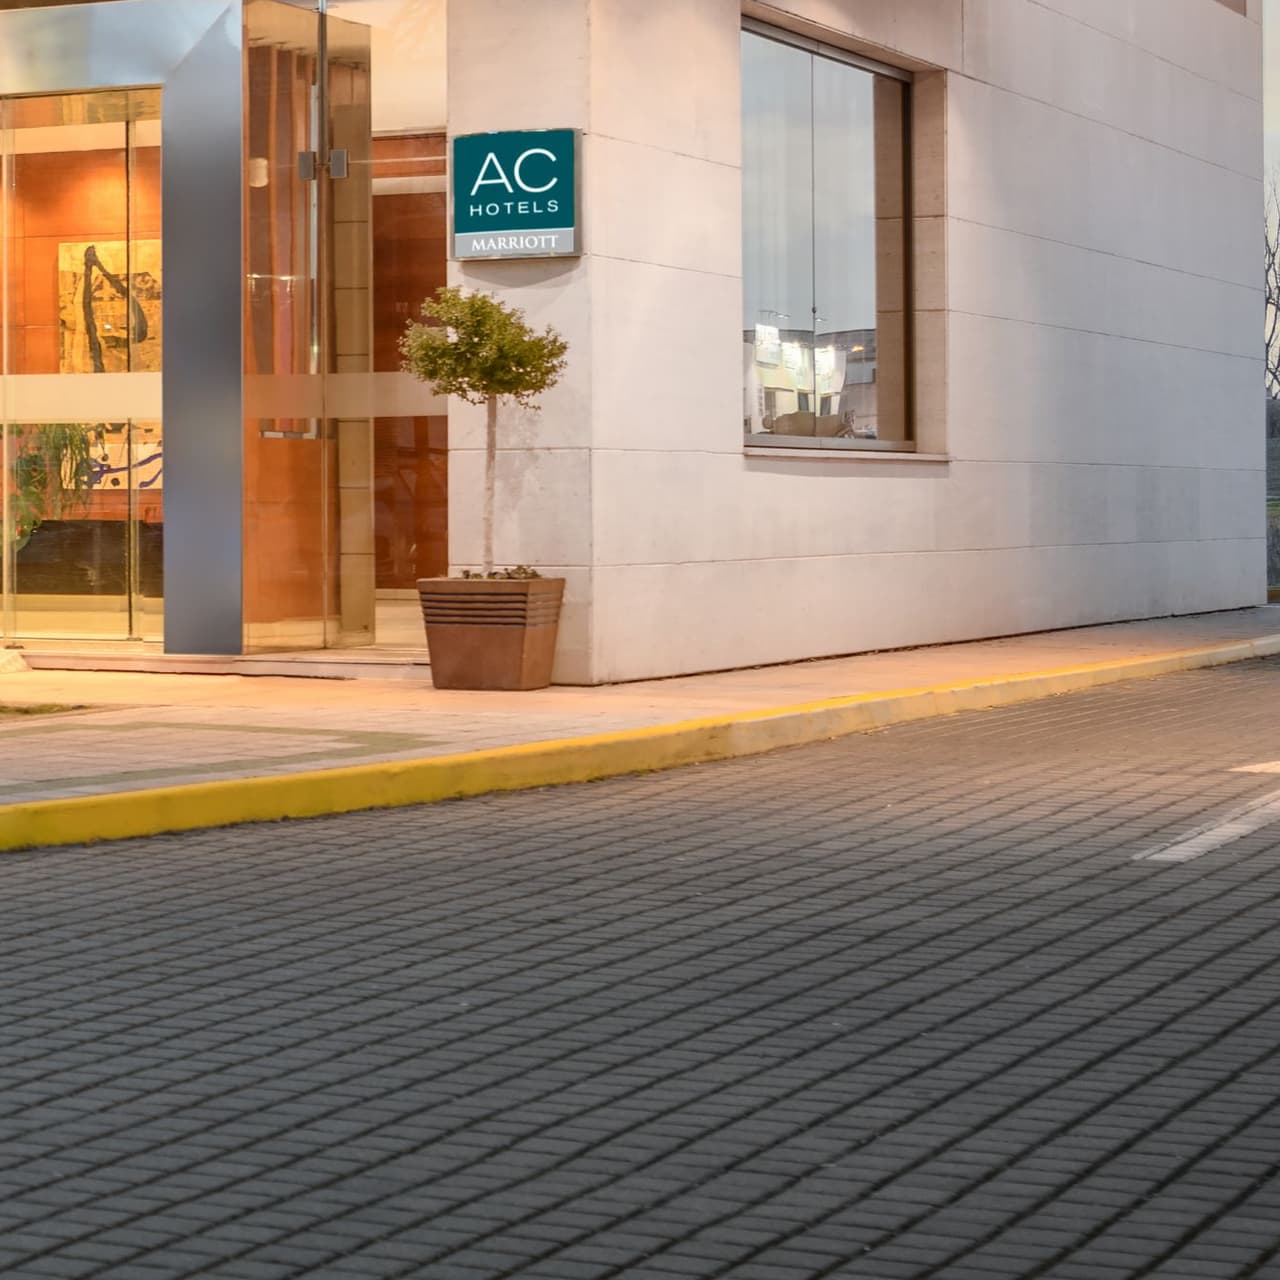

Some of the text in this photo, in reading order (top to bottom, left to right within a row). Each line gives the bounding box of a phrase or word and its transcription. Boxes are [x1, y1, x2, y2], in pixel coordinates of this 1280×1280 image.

[469, 147, 559, 197] AC
[469, 199, 560, 217] HOTELS
[471, 234, 559, 252] MARRIOTT
